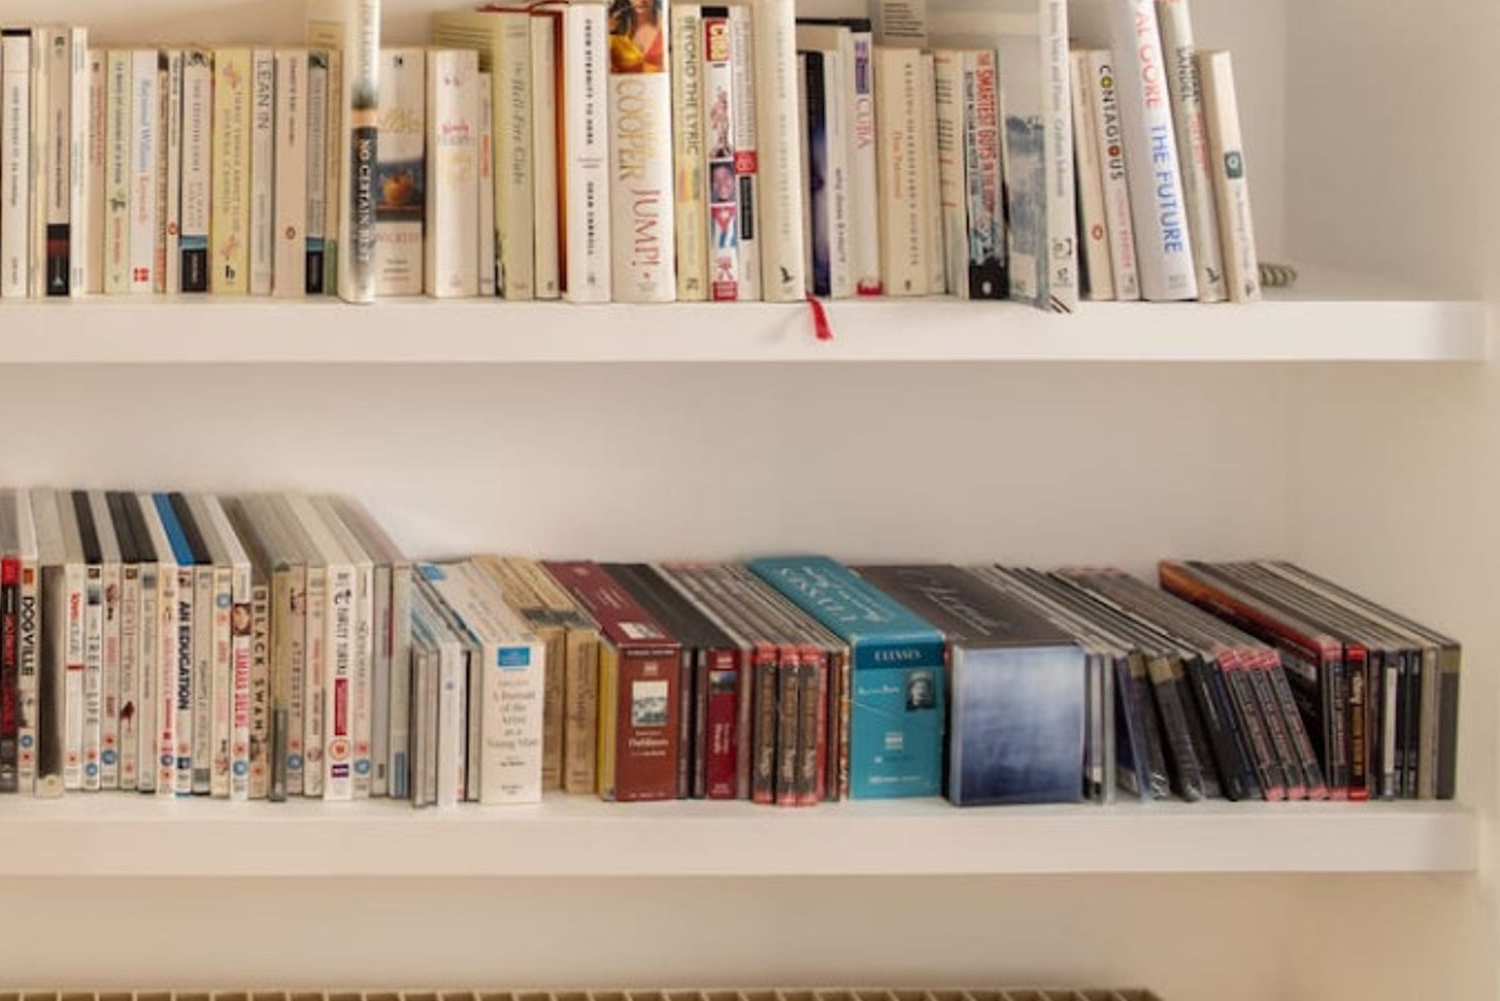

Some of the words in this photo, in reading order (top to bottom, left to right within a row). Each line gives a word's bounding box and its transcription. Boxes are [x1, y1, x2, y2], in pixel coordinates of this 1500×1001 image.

[684, 16, 697, 76] BEYOND
[257, 59, 270, 107] LEAN
[685, 82, 698, 110] THE
[976, 69, 996, 128] SMARTEST
[257, 111, 269, 130] IN
[616, 79, 646, 181] COOPER
[856, 98, 872, 150] CUBA
[1099, 65, 1123, 181] CONTAGIOUS
[1150, 123, 1170, 164] THE
[630, 188, 661, 267] JUMP!
[1156, 171, 1184, 255] FUTURE
[21, 596, 34, 677] DOGVILLE
[180, 601, 191, 622] AN
[254, 604, 265, 667] BLACK
[179, 625, 191, 710] EDUCATION
[254, 679, 265, 731] SWAN
